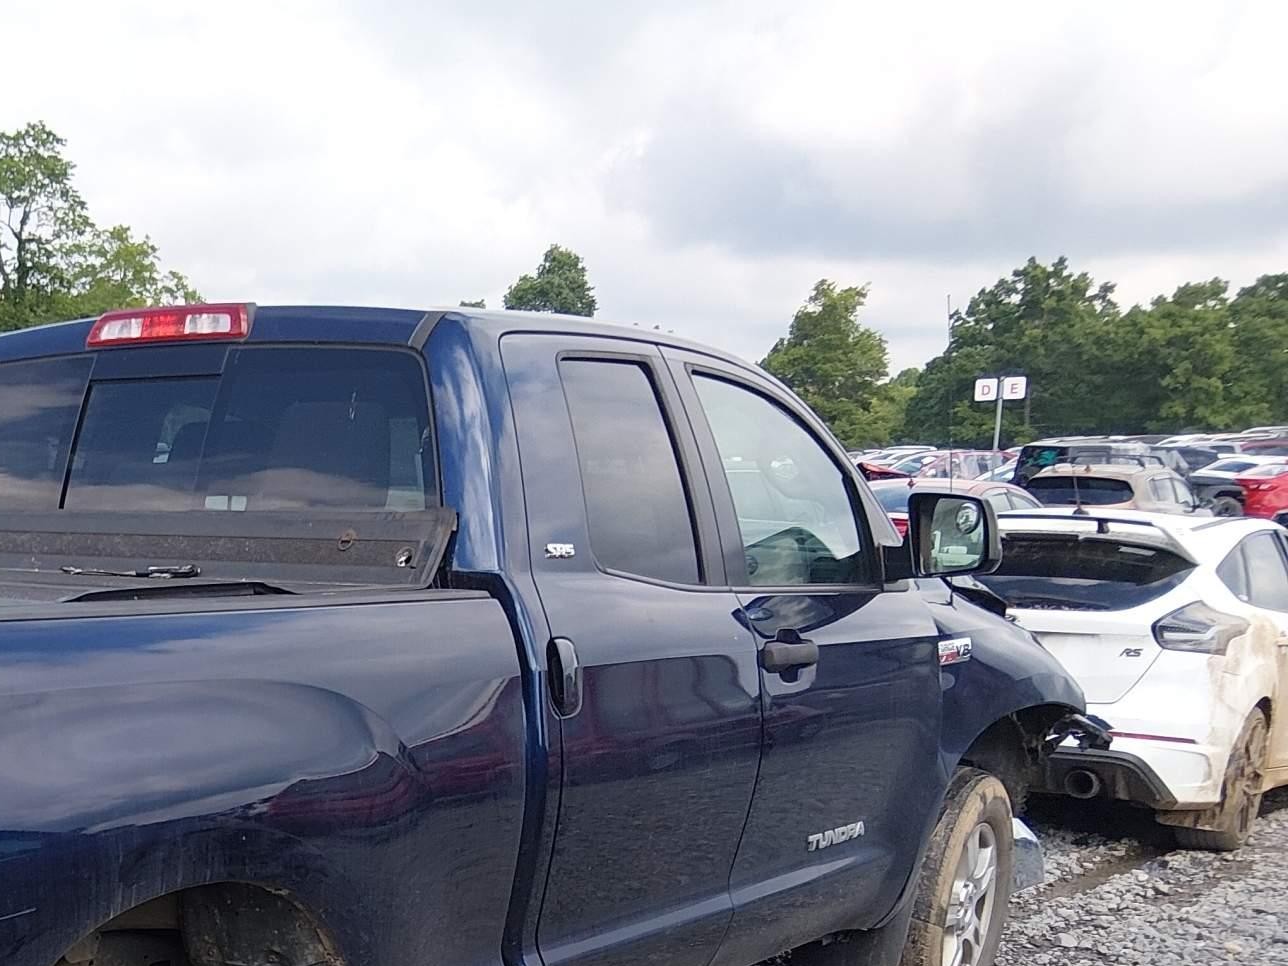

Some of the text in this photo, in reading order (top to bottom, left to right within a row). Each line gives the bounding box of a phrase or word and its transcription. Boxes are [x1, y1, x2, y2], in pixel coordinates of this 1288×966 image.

[981, 384, 991, 396] D
[1010, 383, 1019, 394] E
[1119, 647, 1144, 658] RS
[807, 820, 865, 851] TUNDRA
